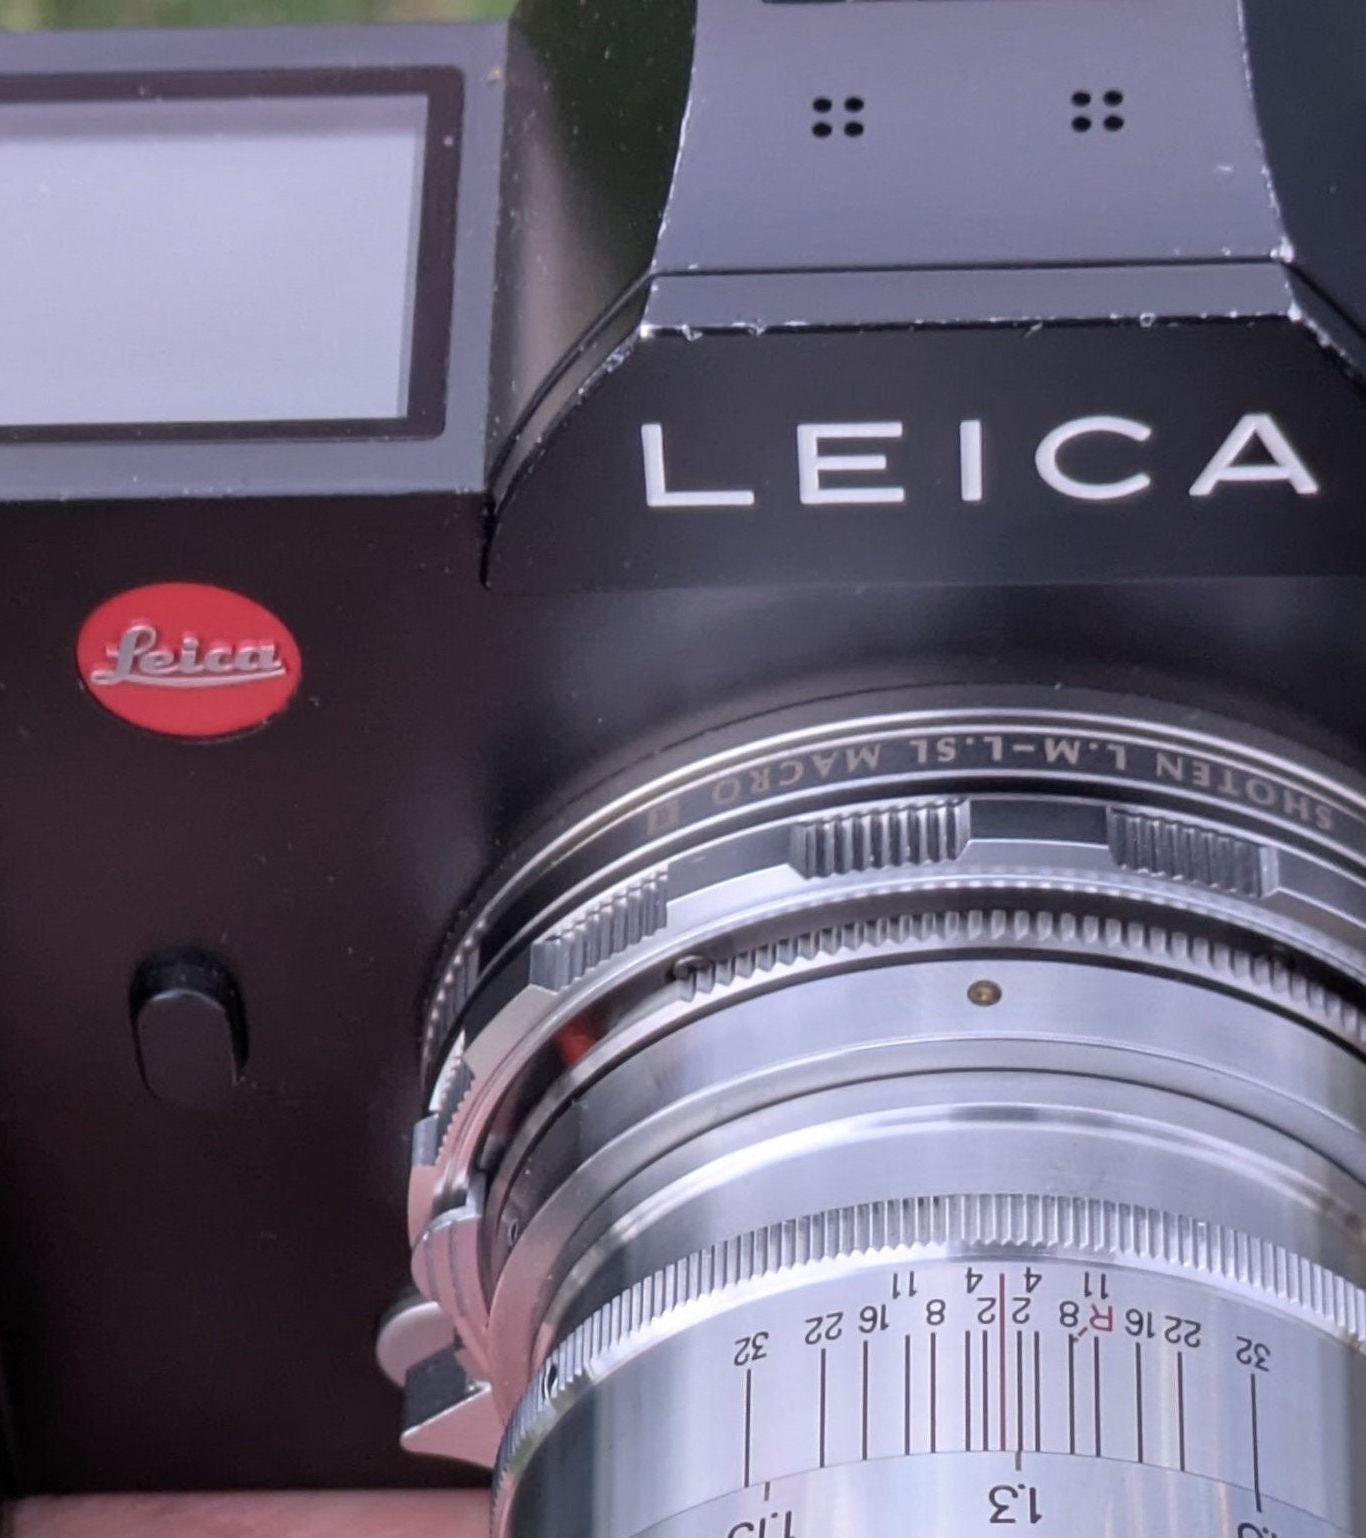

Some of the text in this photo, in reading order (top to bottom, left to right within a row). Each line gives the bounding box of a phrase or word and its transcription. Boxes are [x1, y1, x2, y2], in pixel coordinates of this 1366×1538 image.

[640, 412, 1319, 508] LEICA
[90, 622, 287, 688] Leica
[711, 742, 881, 805] MACRO
[1155, 750, 1333, 831] SHOTEN
[733, 1265, 1271, 1373] 32 22 16 11 8 4 2 2 4 8 11 16 22 32
[1088, 1303, 1114, 1333] R
[987, 1482, 1043, 1525] 1.3
